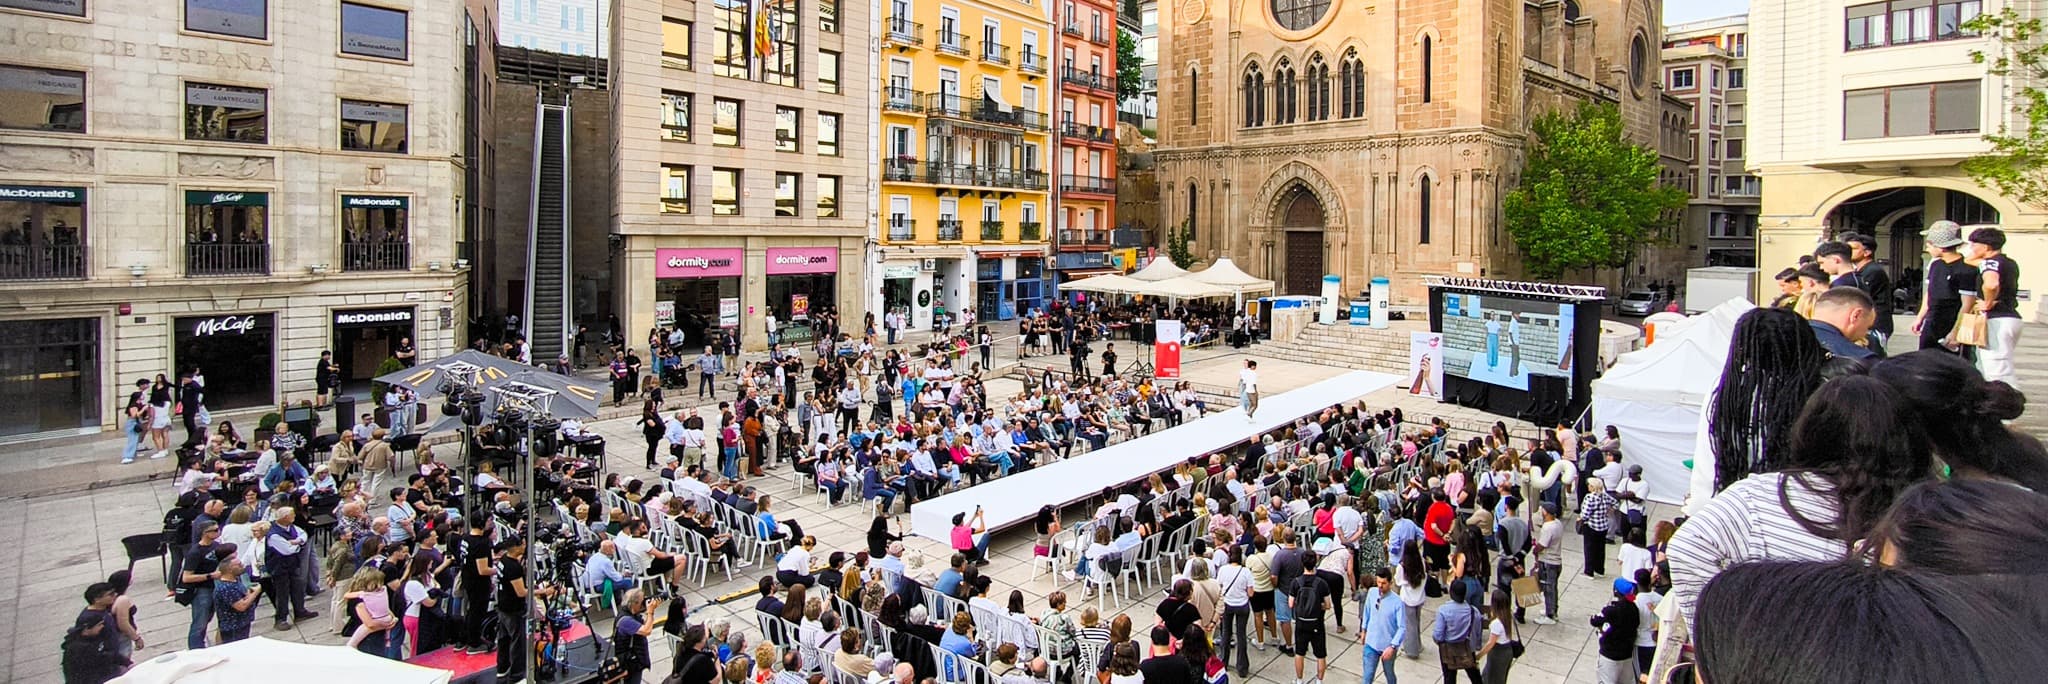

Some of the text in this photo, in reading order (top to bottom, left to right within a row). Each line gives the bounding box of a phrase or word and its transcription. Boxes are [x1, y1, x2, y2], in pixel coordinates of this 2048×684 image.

[102, 38, 136, 57] DE
[159, 45, 276, 73] ESPAÑA
[0, 188, 76, 199] McDonald's
[349, 198, 401, 206] McDonald's
[667, 255, 731, 270] dormity.com
[776, 254, 828, 266] dormity.com
[337, 311, 411, 324] McDonald's
